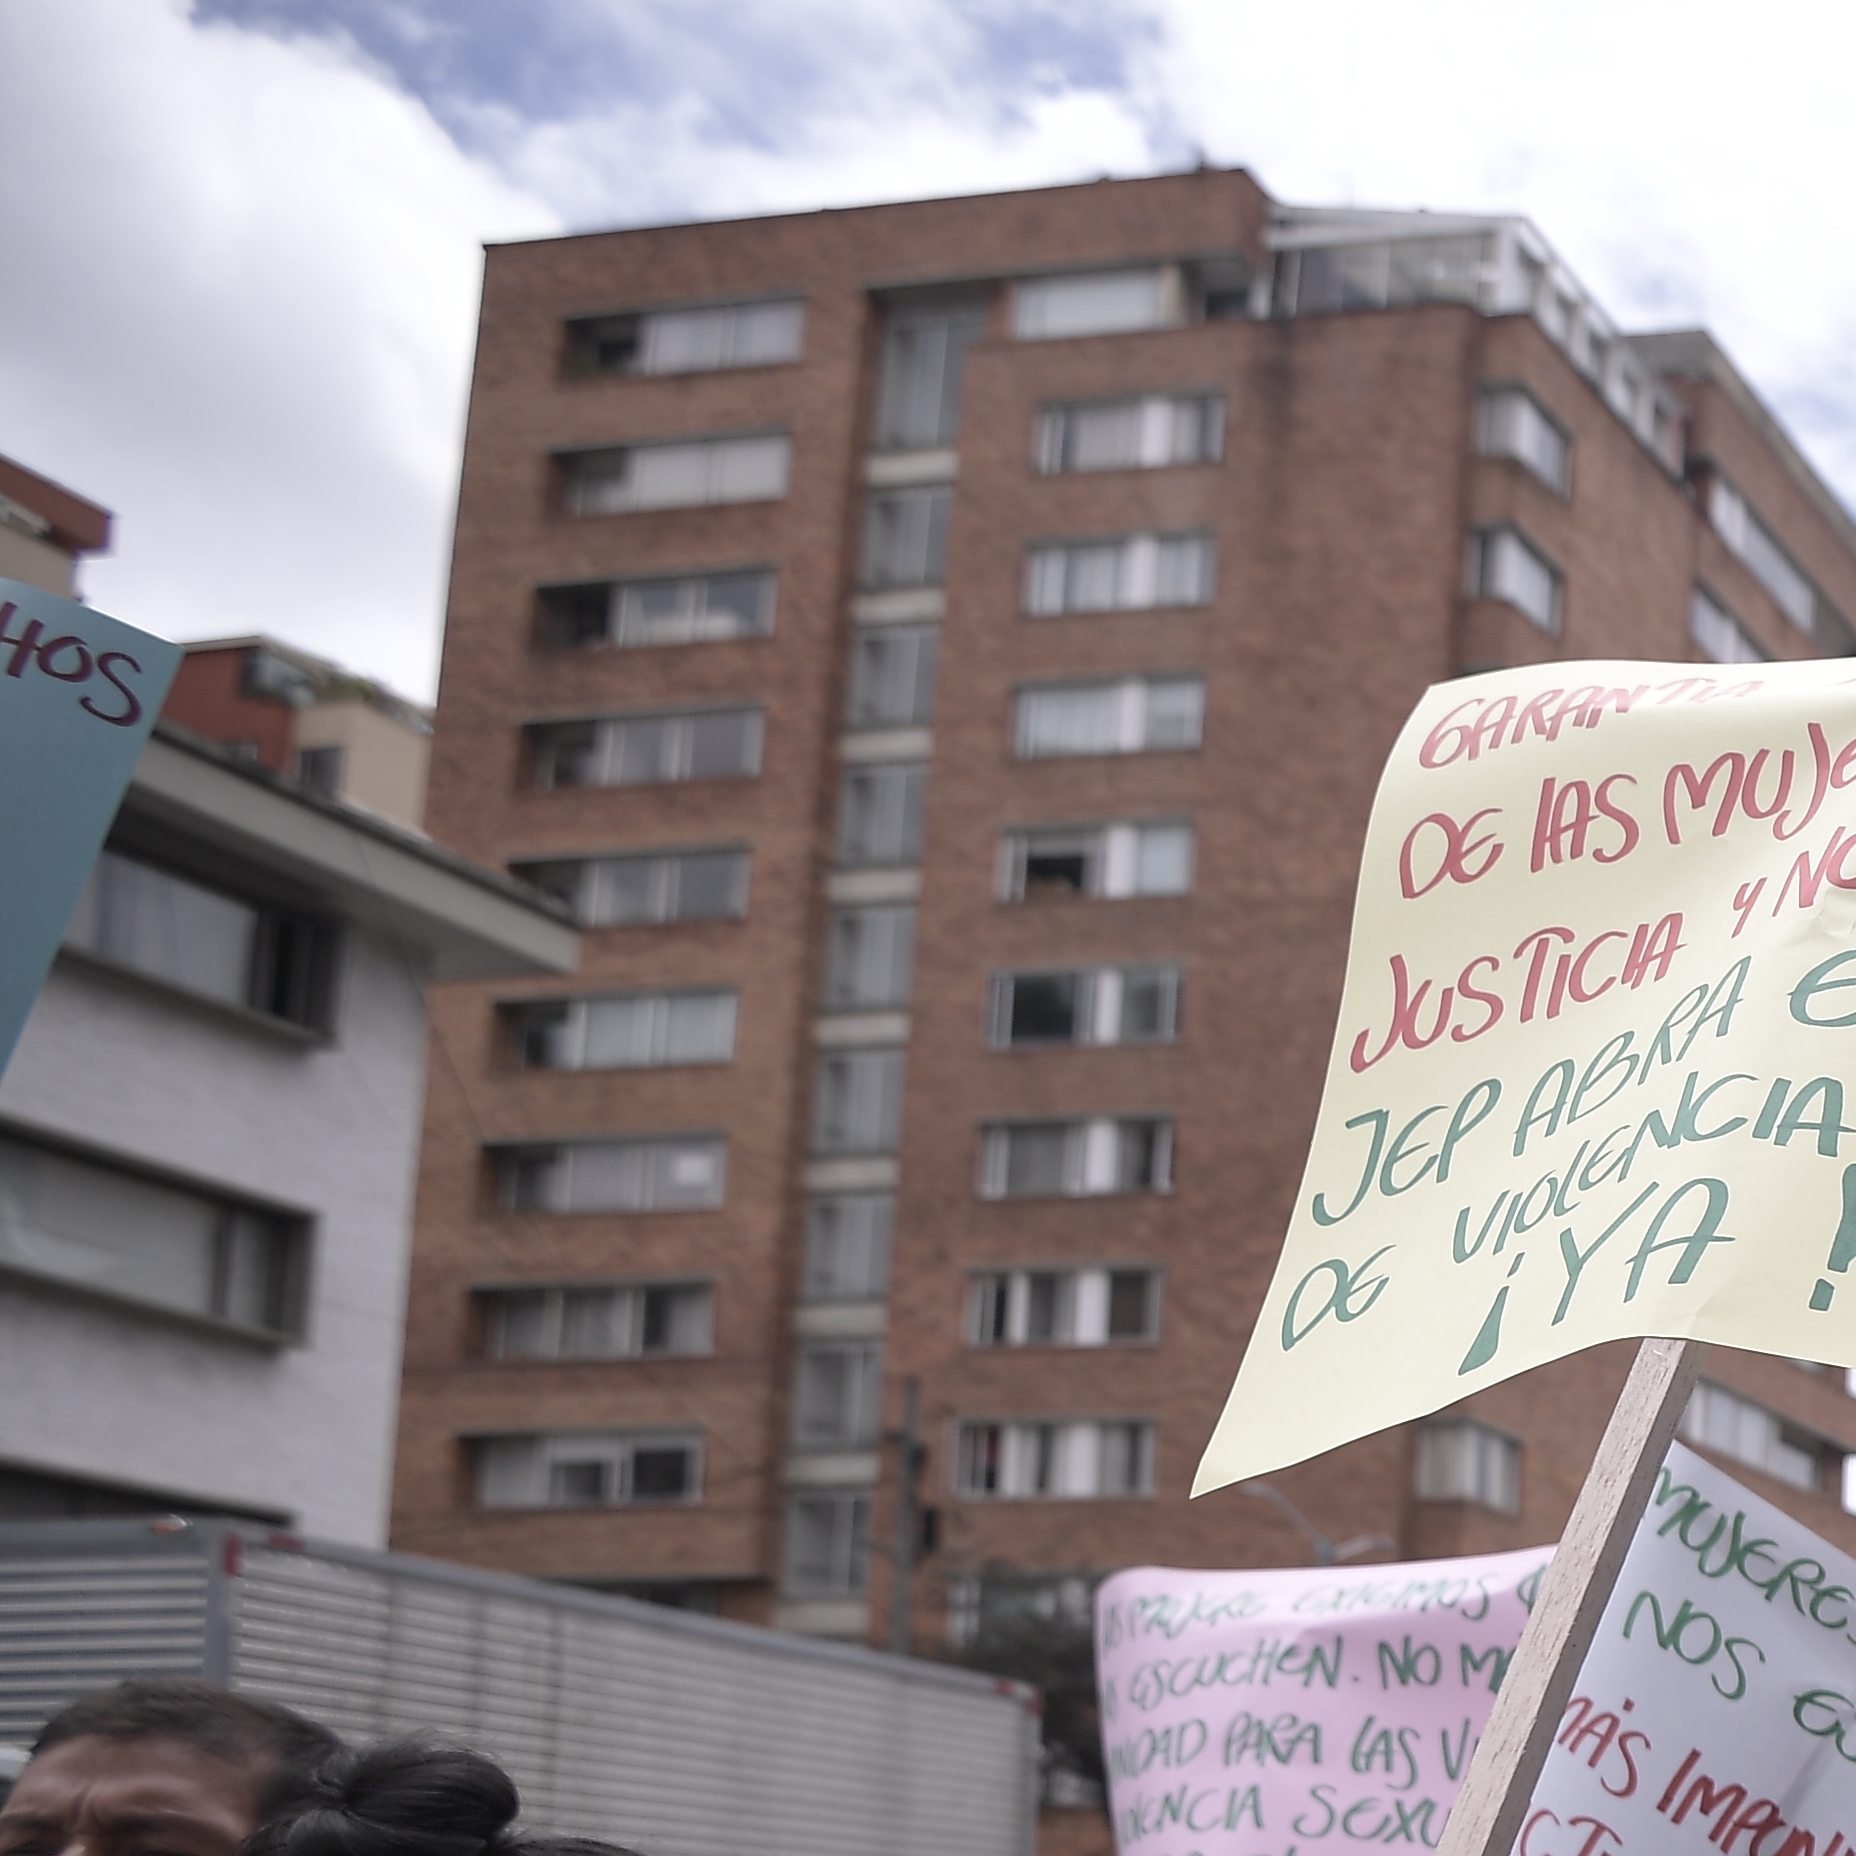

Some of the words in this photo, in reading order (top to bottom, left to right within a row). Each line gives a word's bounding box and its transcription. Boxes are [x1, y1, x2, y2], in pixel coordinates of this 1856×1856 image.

[1400, 806, 1504, 900] DE
[1350, 912, 1688, 1075] JUSTICIA
[1312, 1078, 1502, 1228] JEP
[1512, 954, 1752, 1159] ABRA
[1281, 1244, 1390, 1350] DE
[1378, 1635, 1441, 1690] NO
[1622, 1590, 1766, 1700] NOS
[1292, 1785, 1450, 1849] SEXU
